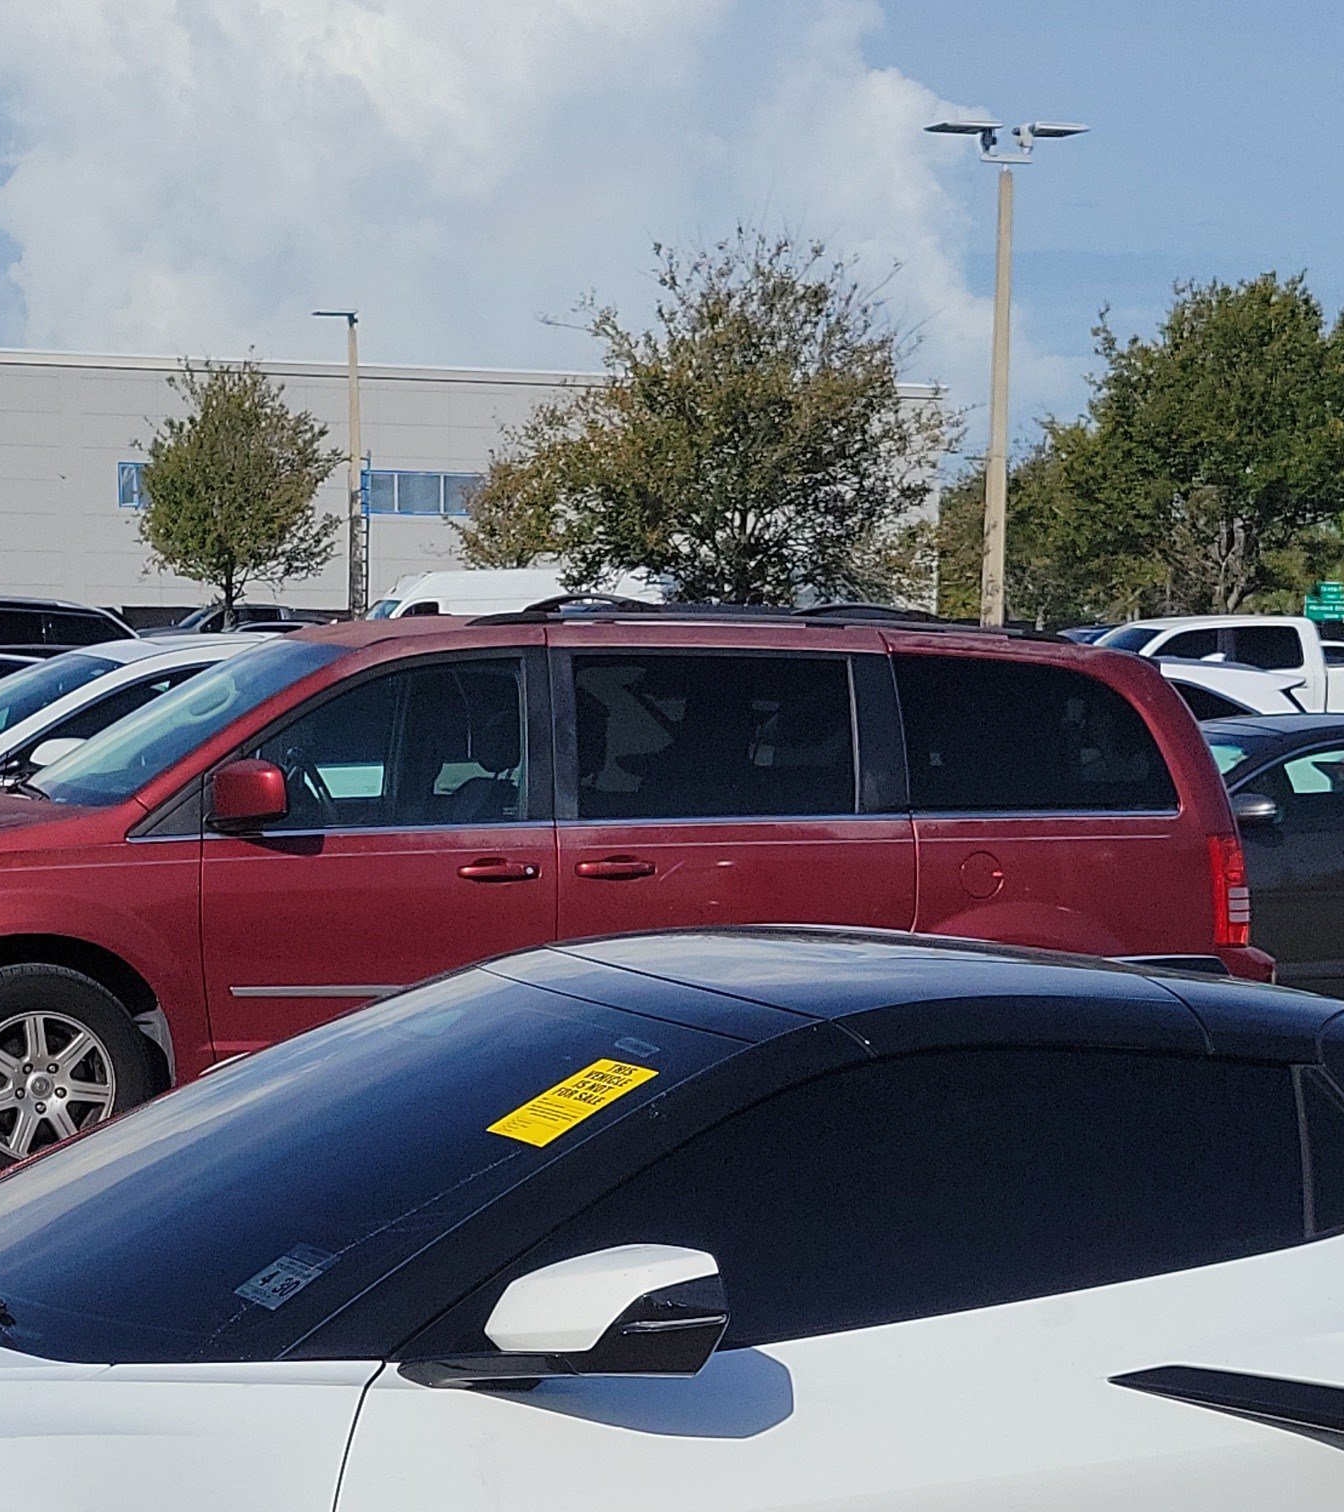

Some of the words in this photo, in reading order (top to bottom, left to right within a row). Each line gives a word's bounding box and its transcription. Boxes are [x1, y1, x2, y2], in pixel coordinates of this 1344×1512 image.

[583, 1069, 633, 1087] VEHICLE
[606, 1063, 638, 1076] THIS
[571, 1079, 592, 1090] IS
[585, 1082, 616, 1095] NOT
[550, 1086, 578, 1099] FOR
[572, 1091, 606, 1106] SALE
